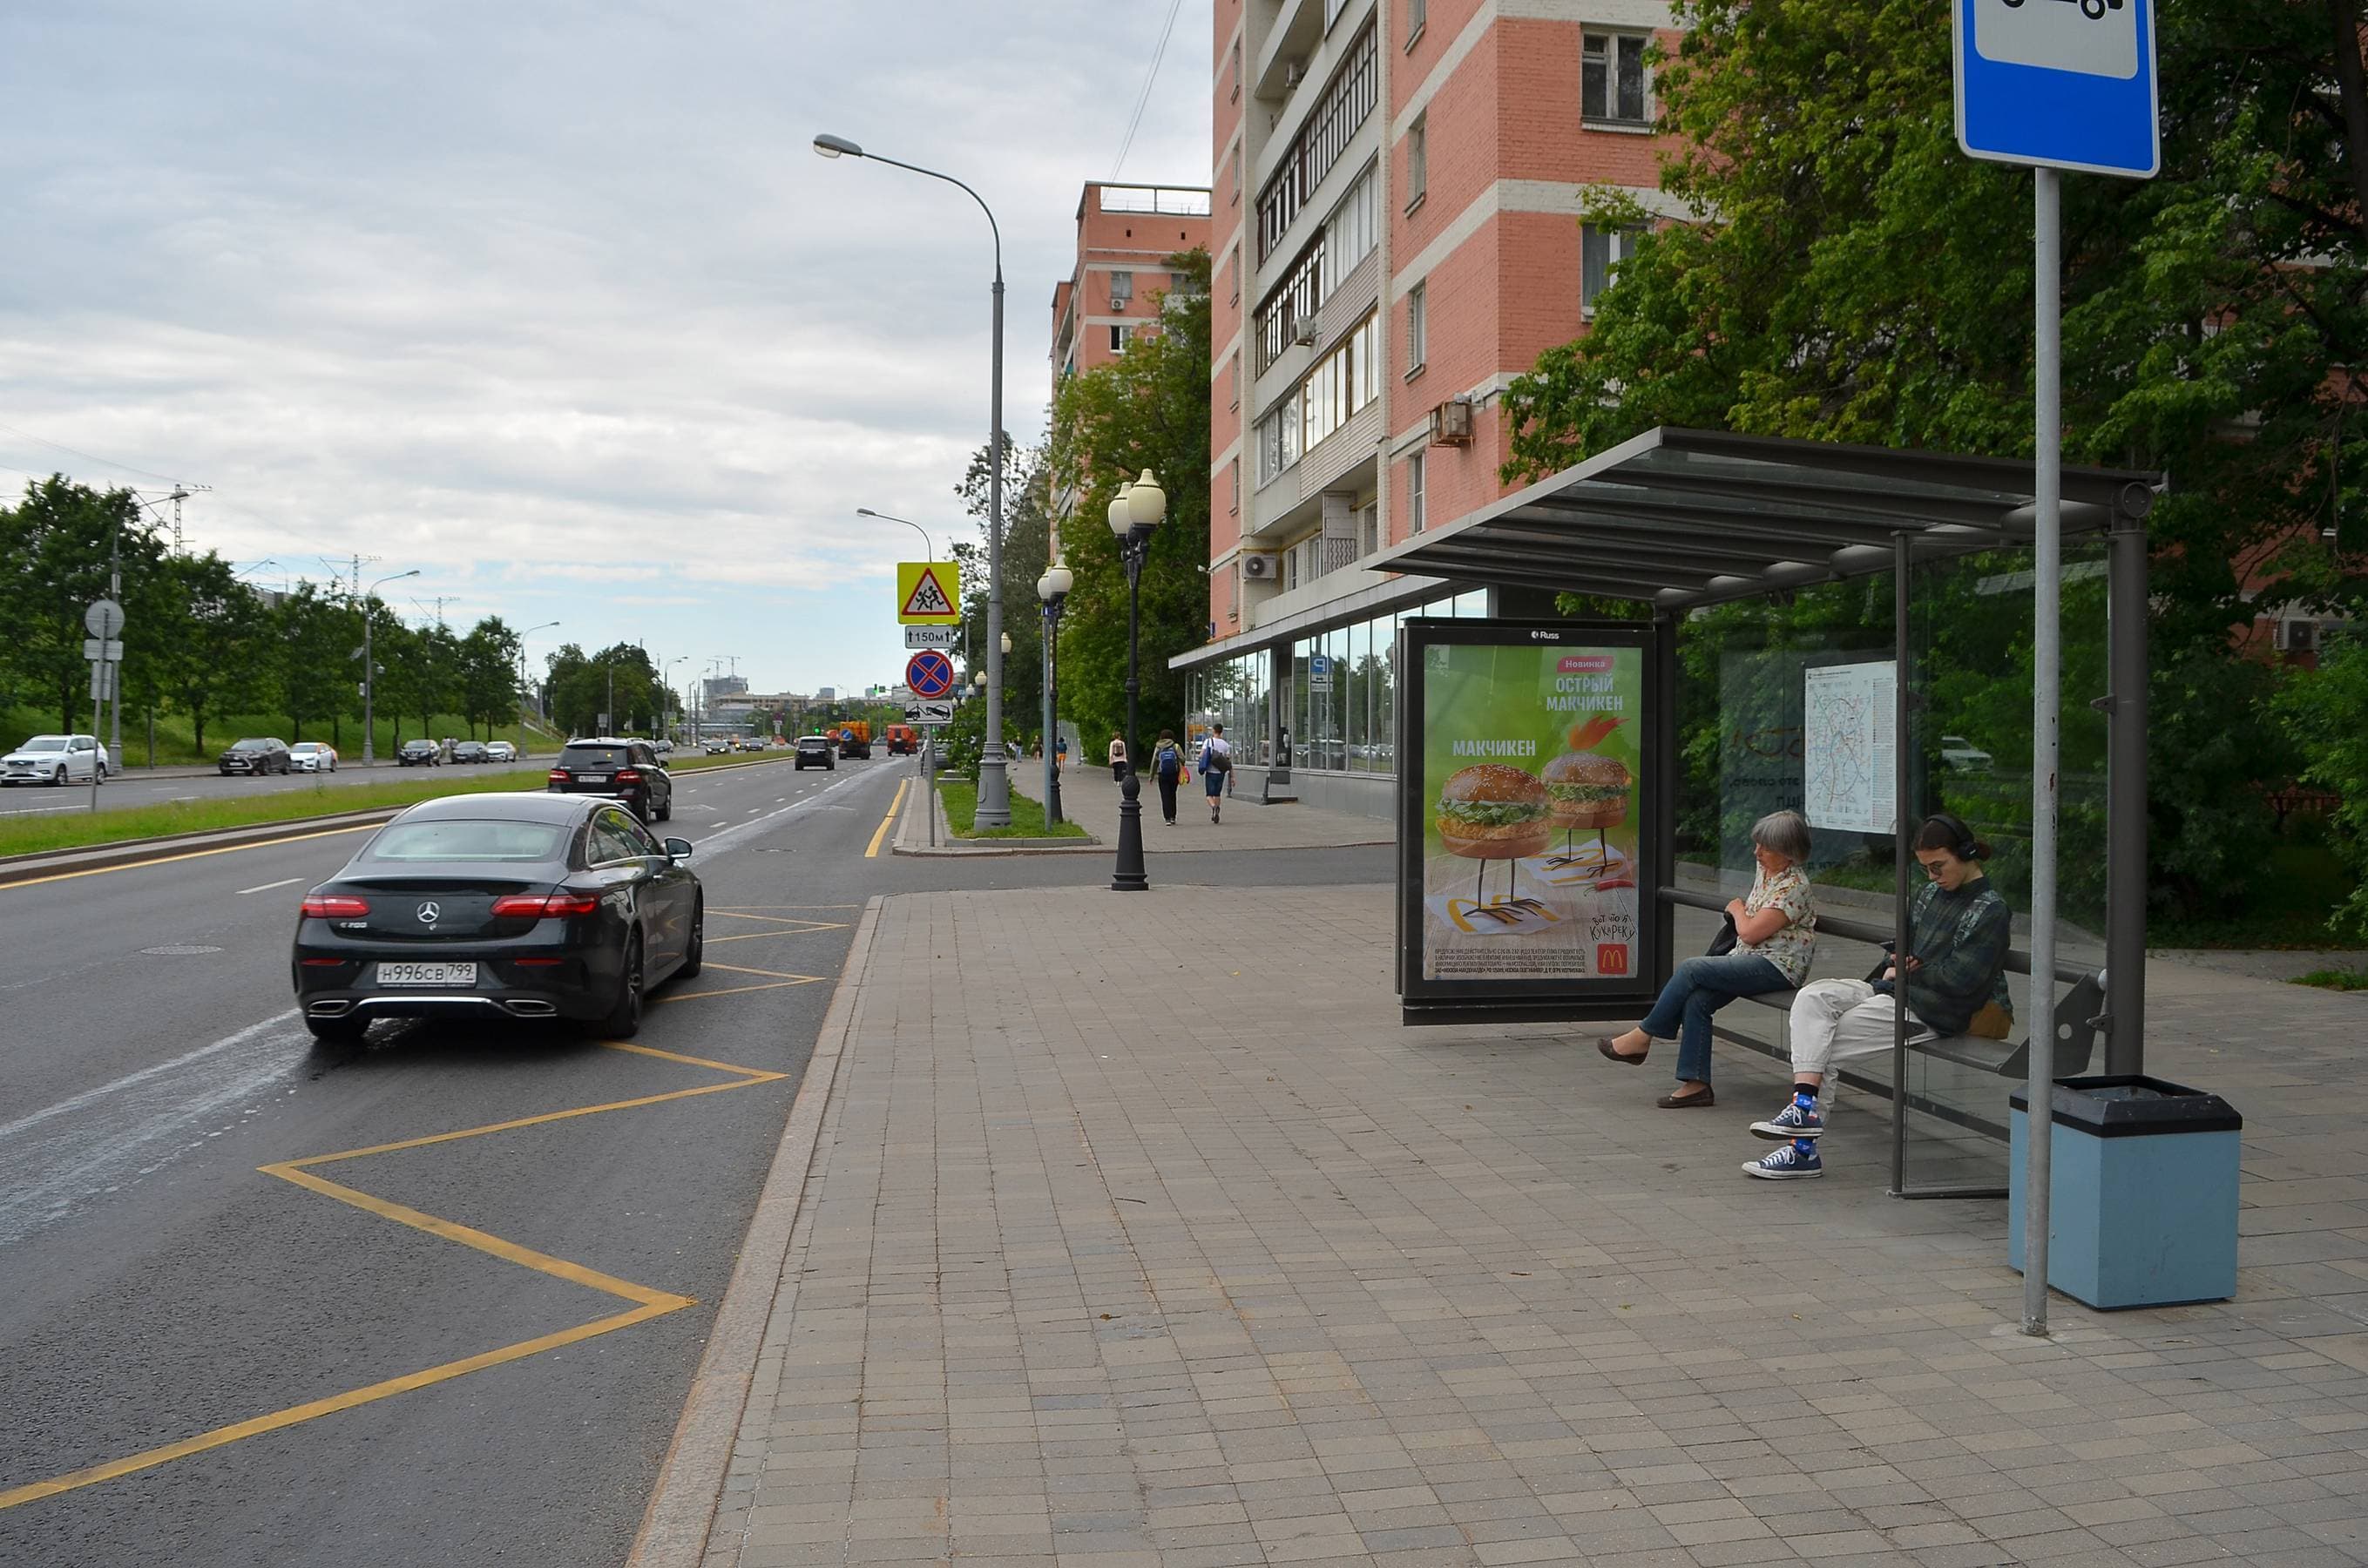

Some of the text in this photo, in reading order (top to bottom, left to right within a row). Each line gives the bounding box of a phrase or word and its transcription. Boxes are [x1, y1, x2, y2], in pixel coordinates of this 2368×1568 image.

[1540, 631, 1559, 639] Russ
[1565, 659, 1606, 668] Новинка
[1555, 672, 1614, 693] ОСТРЫЙ
[1546, 695, 1623, 712] МАКЧИКЕН
[1452, 740, 1537, 756] МАКЧИКЕН
